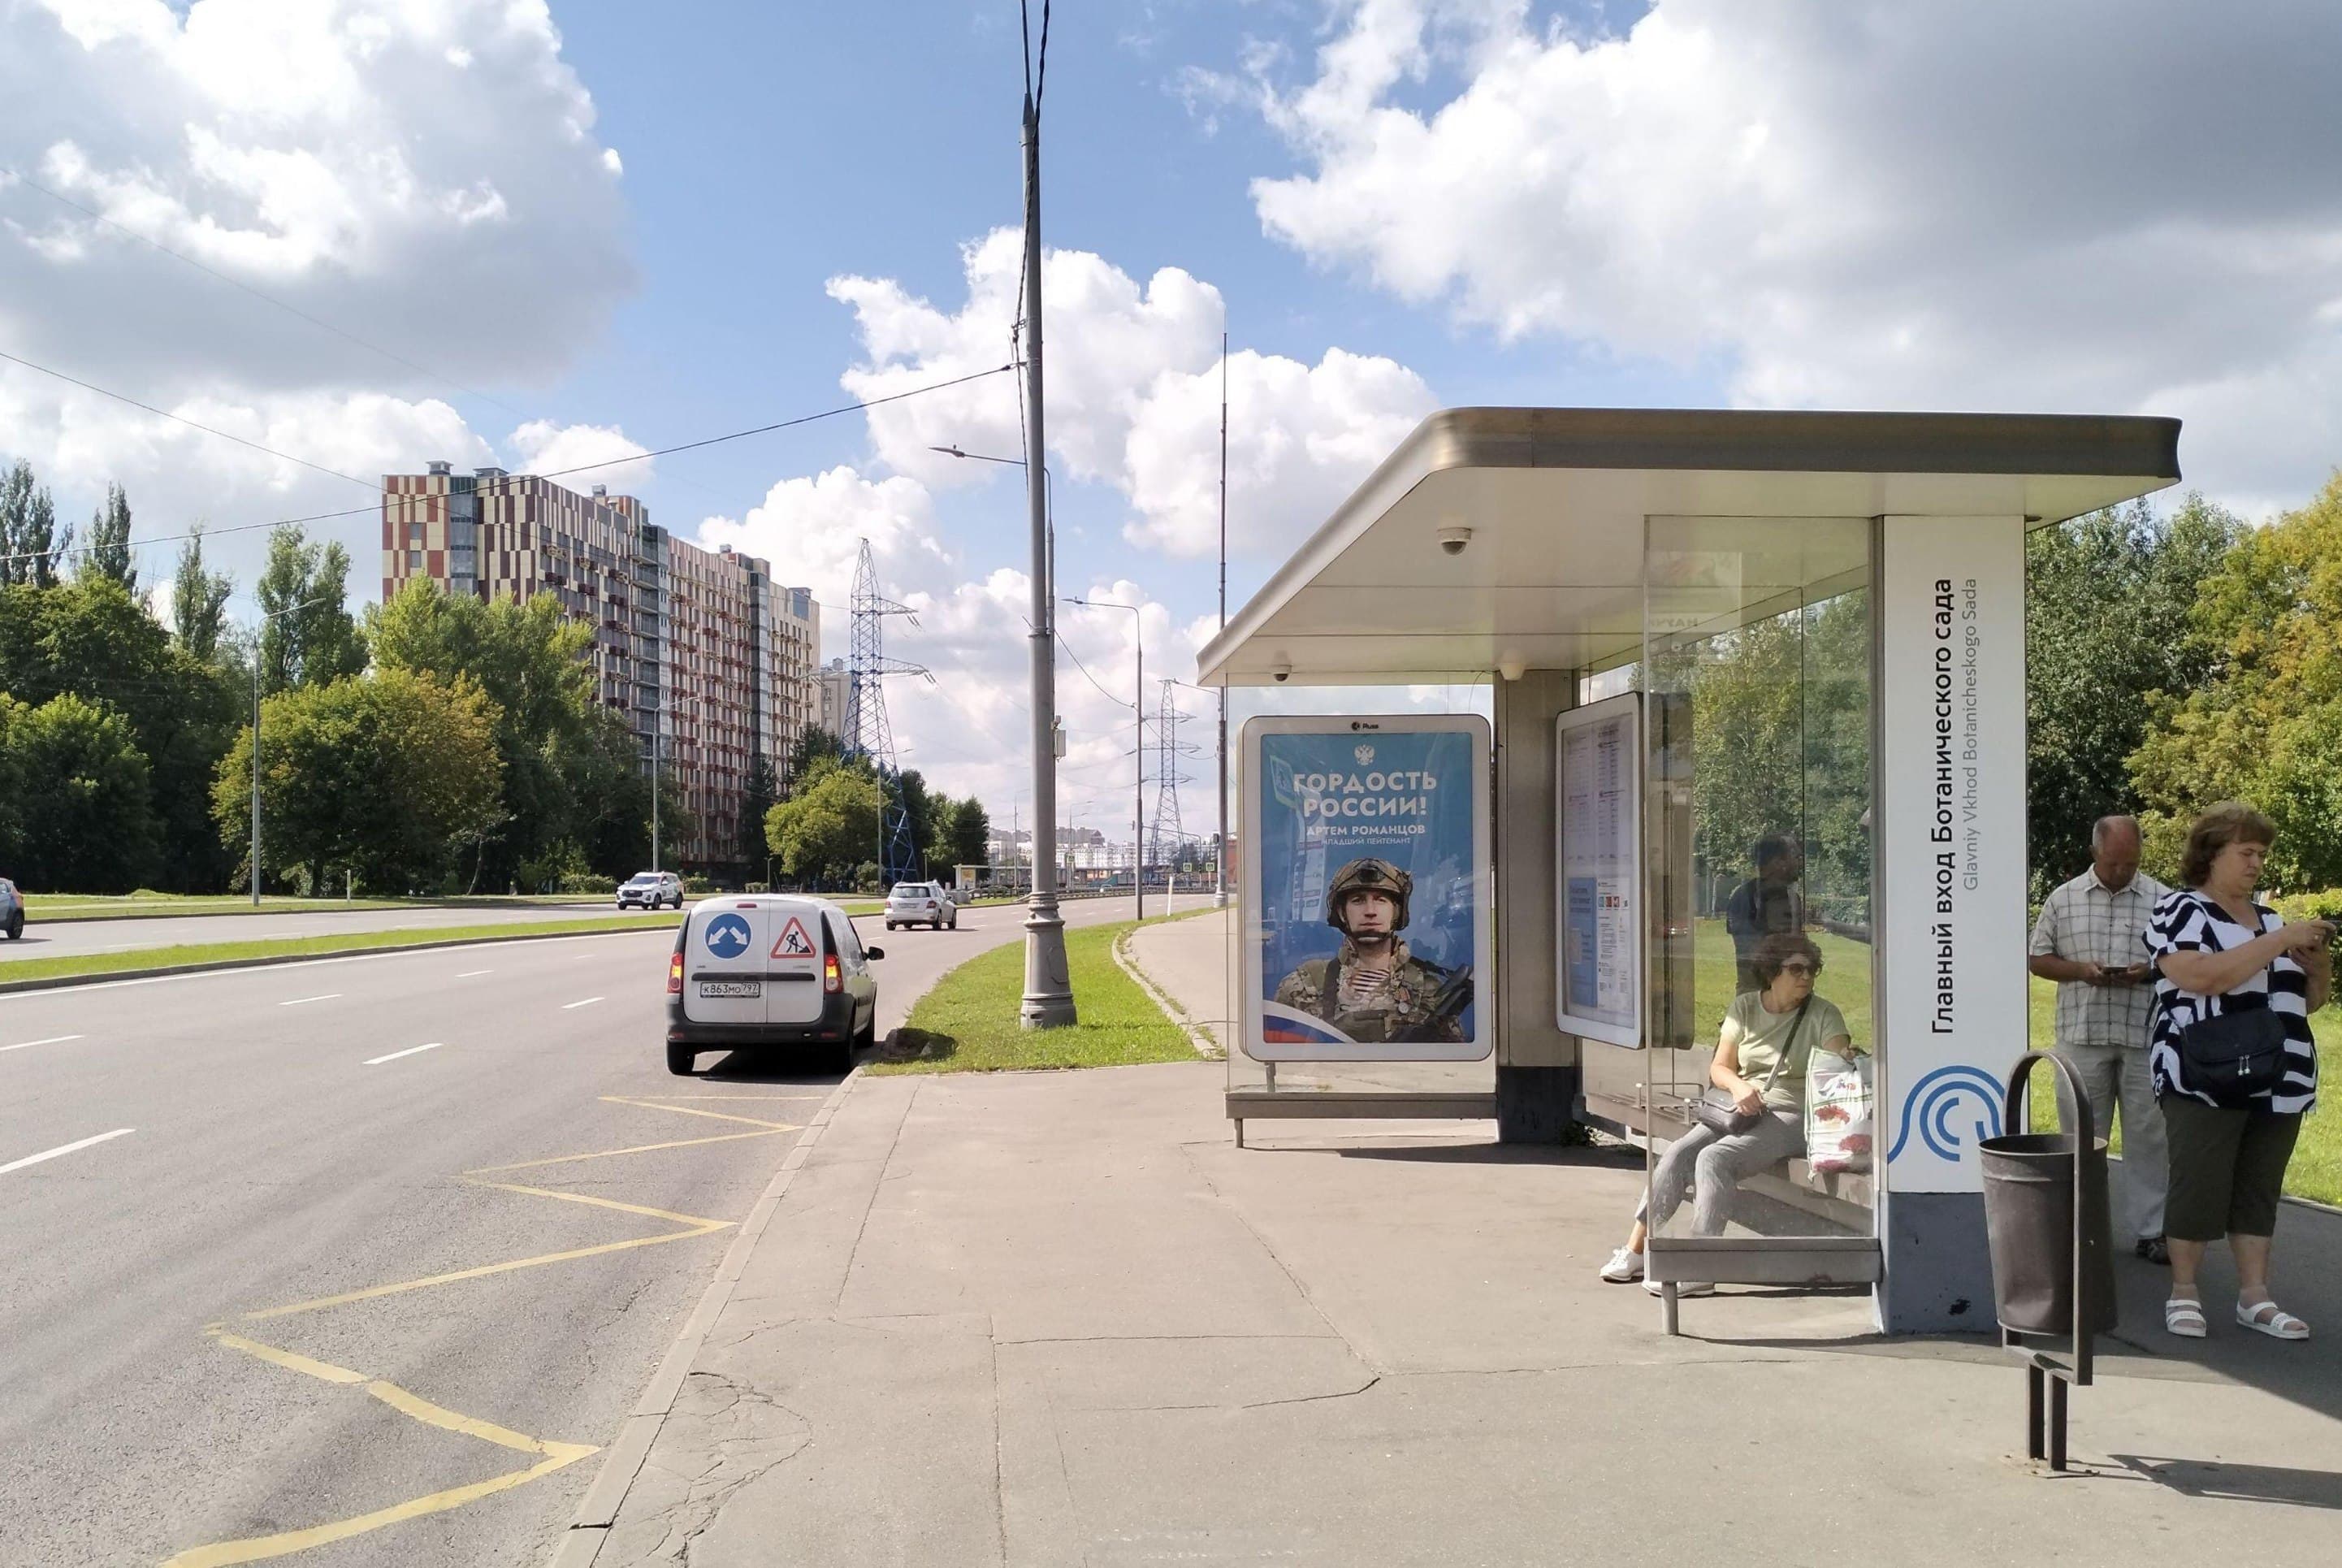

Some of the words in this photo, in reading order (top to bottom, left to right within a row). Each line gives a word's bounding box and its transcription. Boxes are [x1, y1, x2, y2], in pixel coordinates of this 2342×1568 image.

[1935, 578, 1955, 640] сада
[1961, 578, 1977, 621] Sada
[1961, 625, 1981, 761] Botanicheskogo
[1930, 647, 1953, 842] Ботанического
[1293, 772, 1437, 794] ГОРДОСТЬ
[1303, 796, 1427, 817] РОССИИ!
[1962, 766, 1978, 823] Vkhod
[1306, 825, 1348, 836] АРТЕМ
[1352, 825, 1426, 836] РОМАНЦОВ
[1962, 827, 1981, 891] Glavniy
[1936, 852, 1956, 913] вход
[1931, 923, 1954, 1034] Главный
